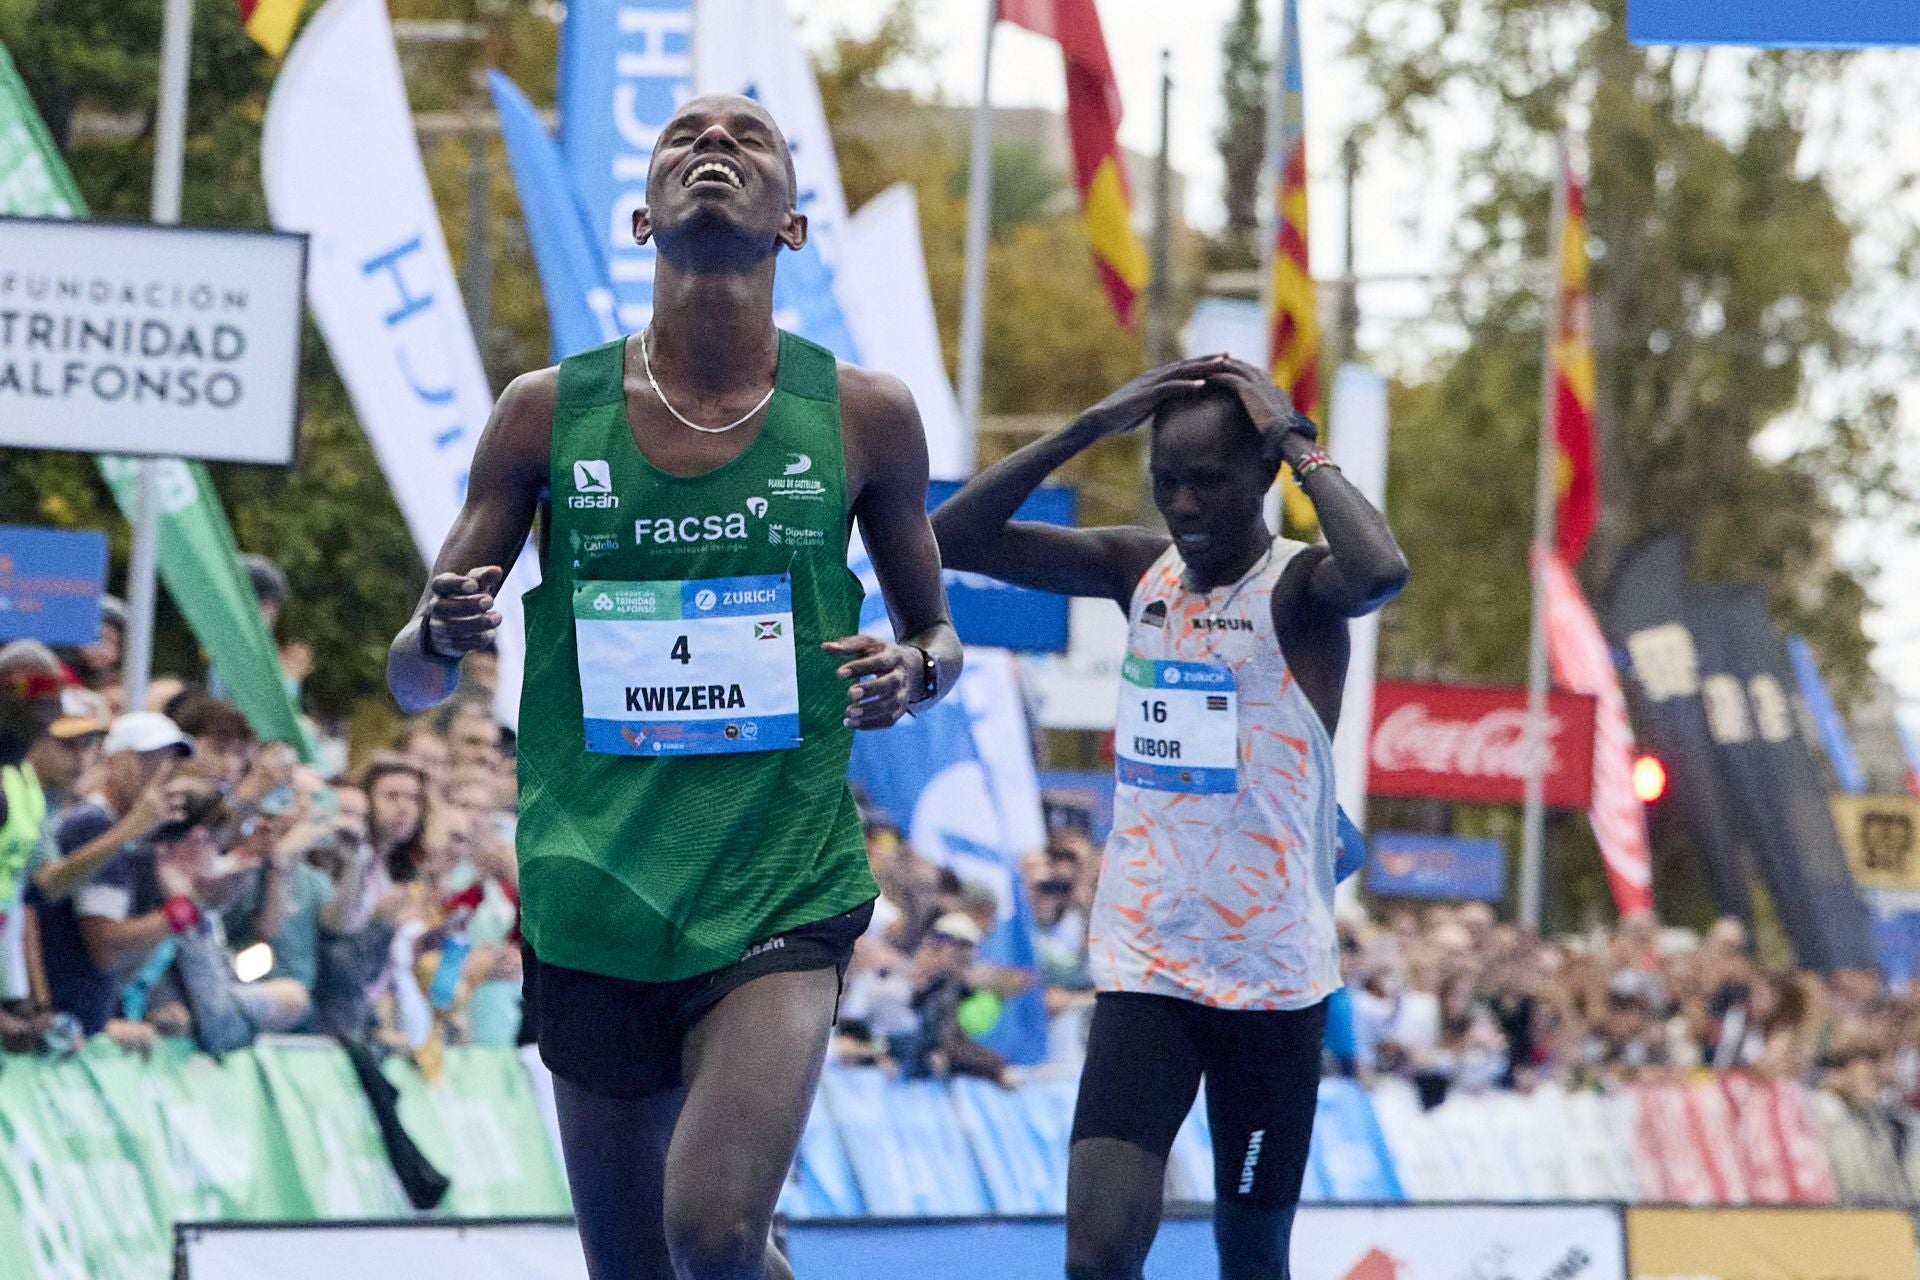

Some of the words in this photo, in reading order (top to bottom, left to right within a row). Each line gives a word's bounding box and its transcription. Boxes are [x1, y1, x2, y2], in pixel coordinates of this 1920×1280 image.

[0, 309, 246, 363] TRINIDAD
[0, 359, 244, 409] ALFONSO
[568, 493, 619, 509] rasán
[635, 512, 748, 545] Facsa
[722, 589, 776, 606] ZURICH
[670, 635, 691, 664] 4
[625, 683, 746, 712] KWIZERA
[1141, 700, 1167, 723] 16
[1134, 737, 1181, 759] KIBOR
